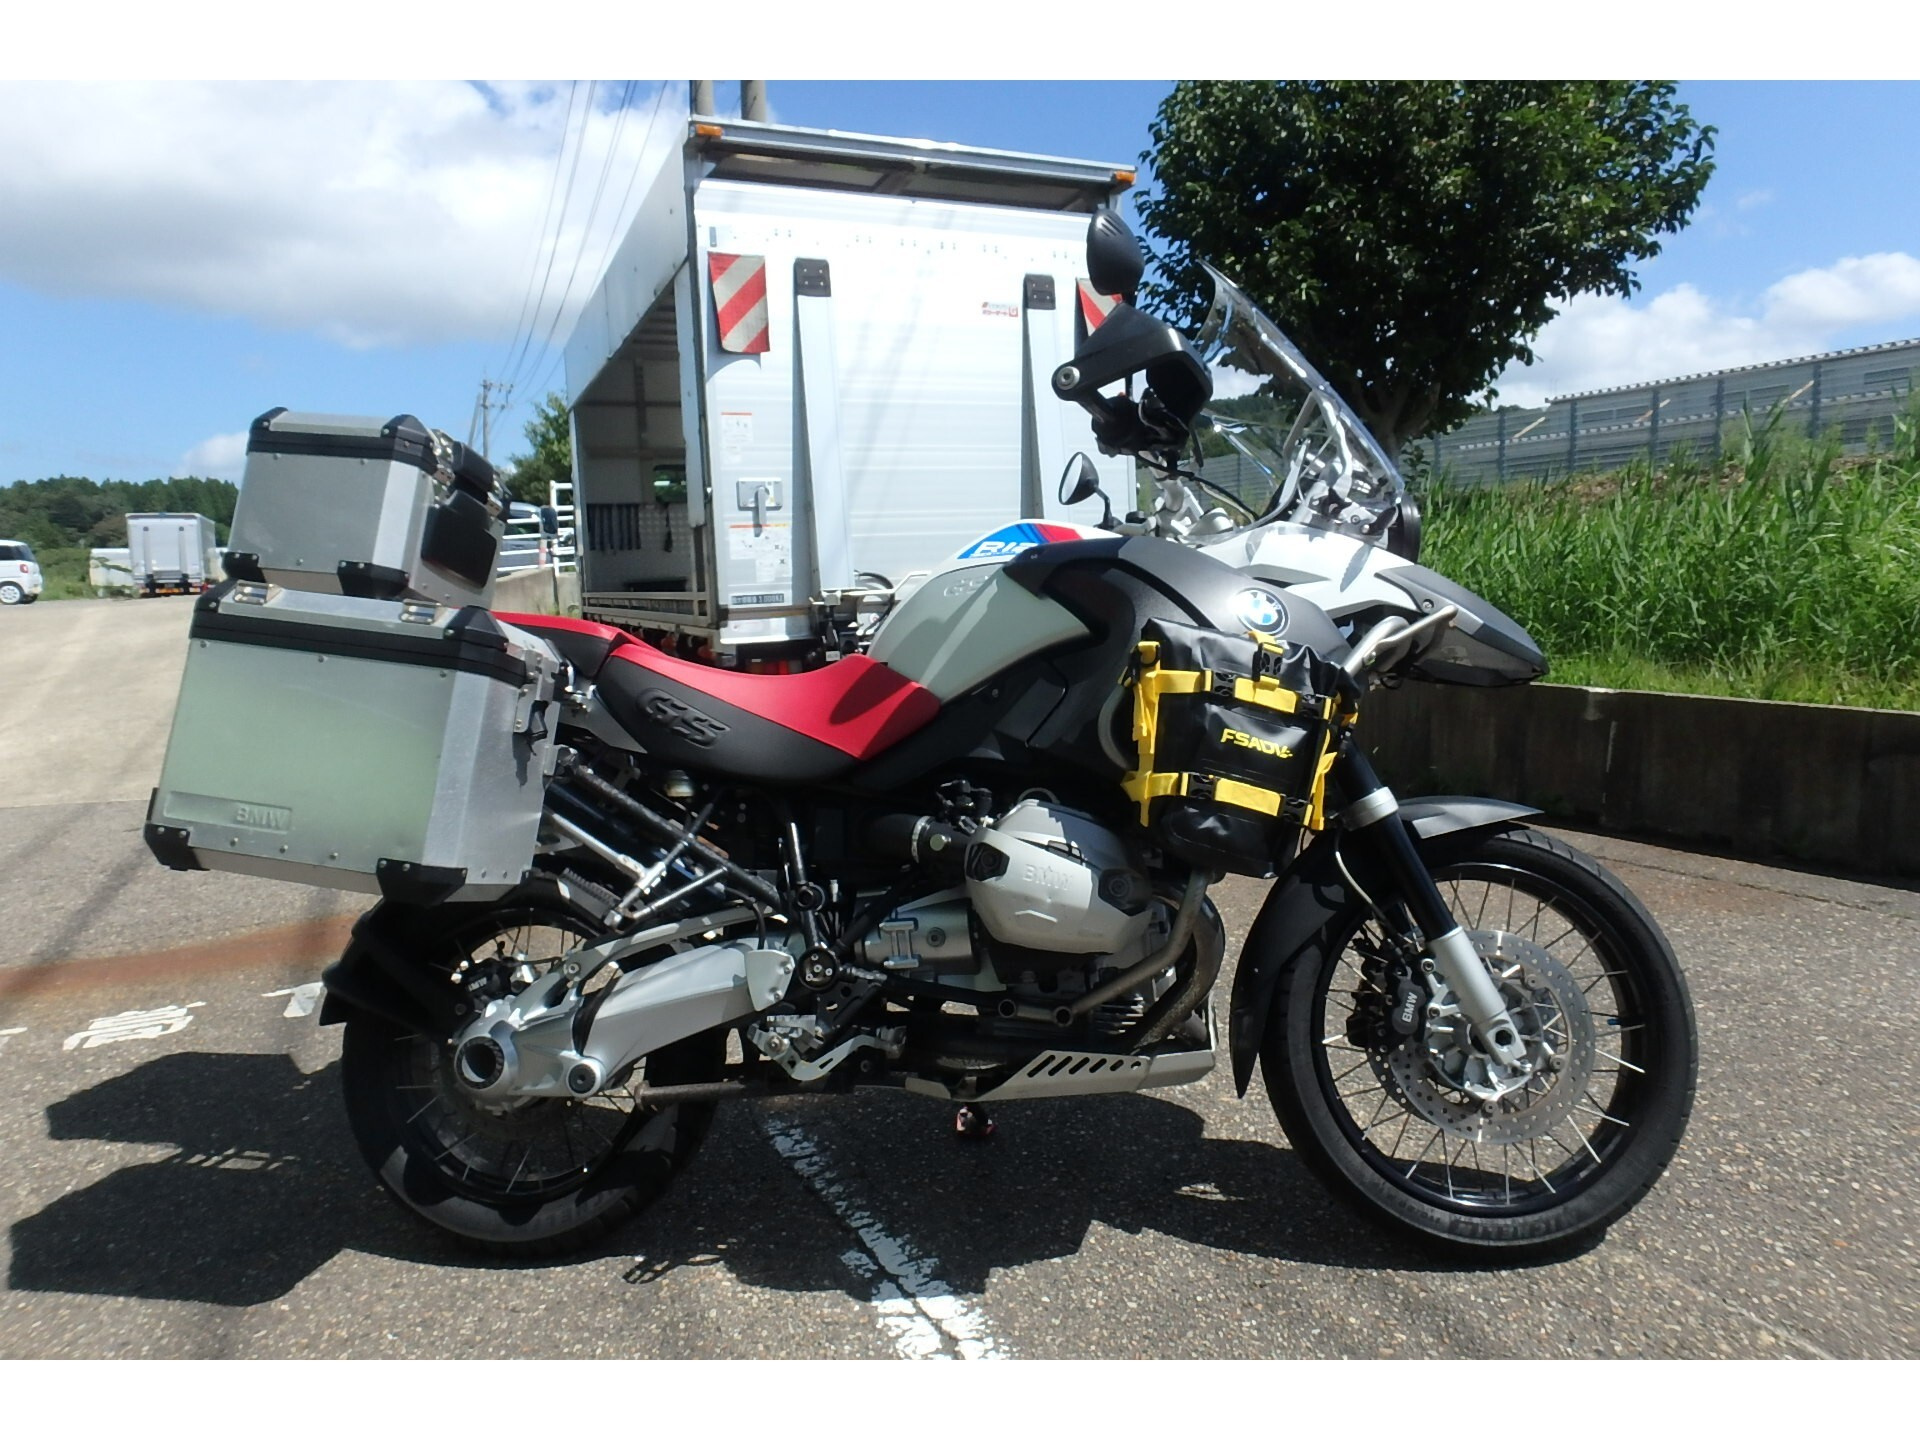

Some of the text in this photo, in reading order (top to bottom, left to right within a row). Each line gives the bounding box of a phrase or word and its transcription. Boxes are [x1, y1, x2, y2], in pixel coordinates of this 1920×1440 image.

[1220, 727, 1293, 759] FSADV
[236, 804, 290, 832] BMW
[1023, 864, 1074, 891] BMW
[1401, 991, 1418, 1023] BMW
